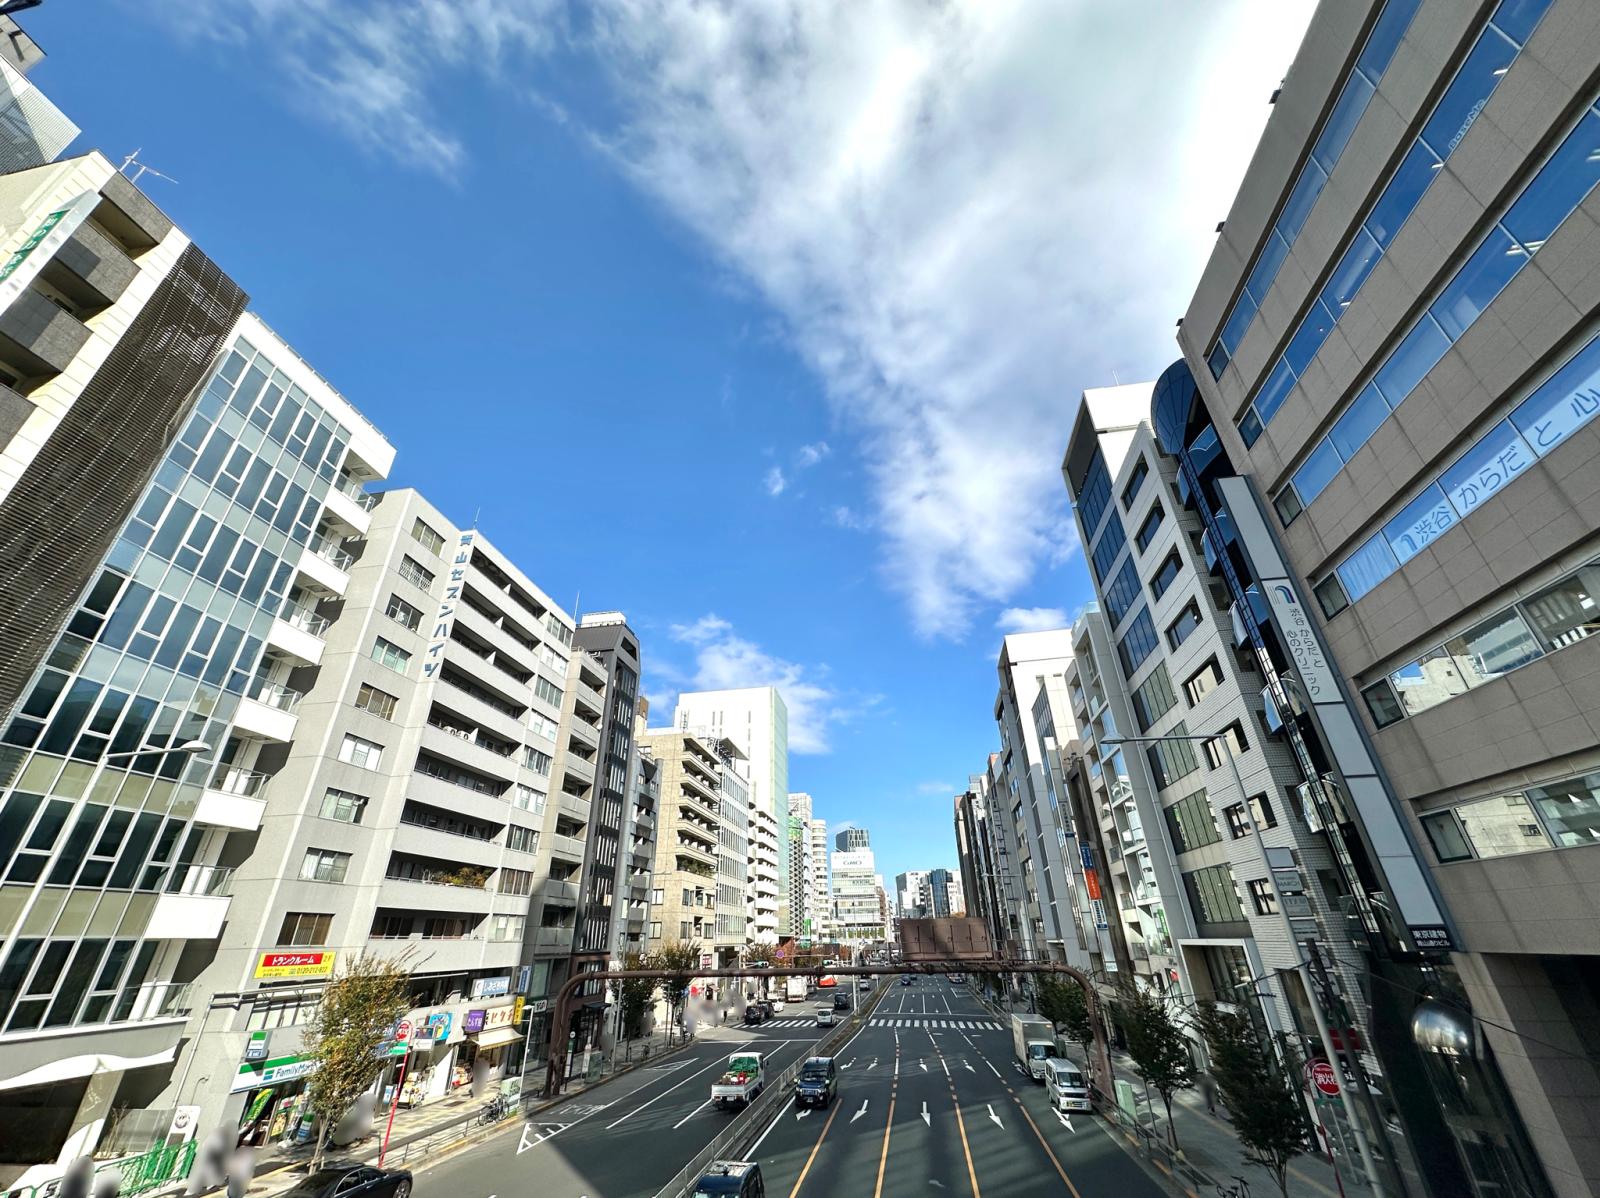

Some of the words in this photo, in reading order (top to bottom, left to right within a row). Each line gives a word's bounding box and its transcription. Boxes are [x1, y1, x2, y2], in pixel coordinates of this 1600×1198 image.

[424, 534, 474, 678] 青山セブンハイツ
[272, 956, 314, 966] トランクルーム
